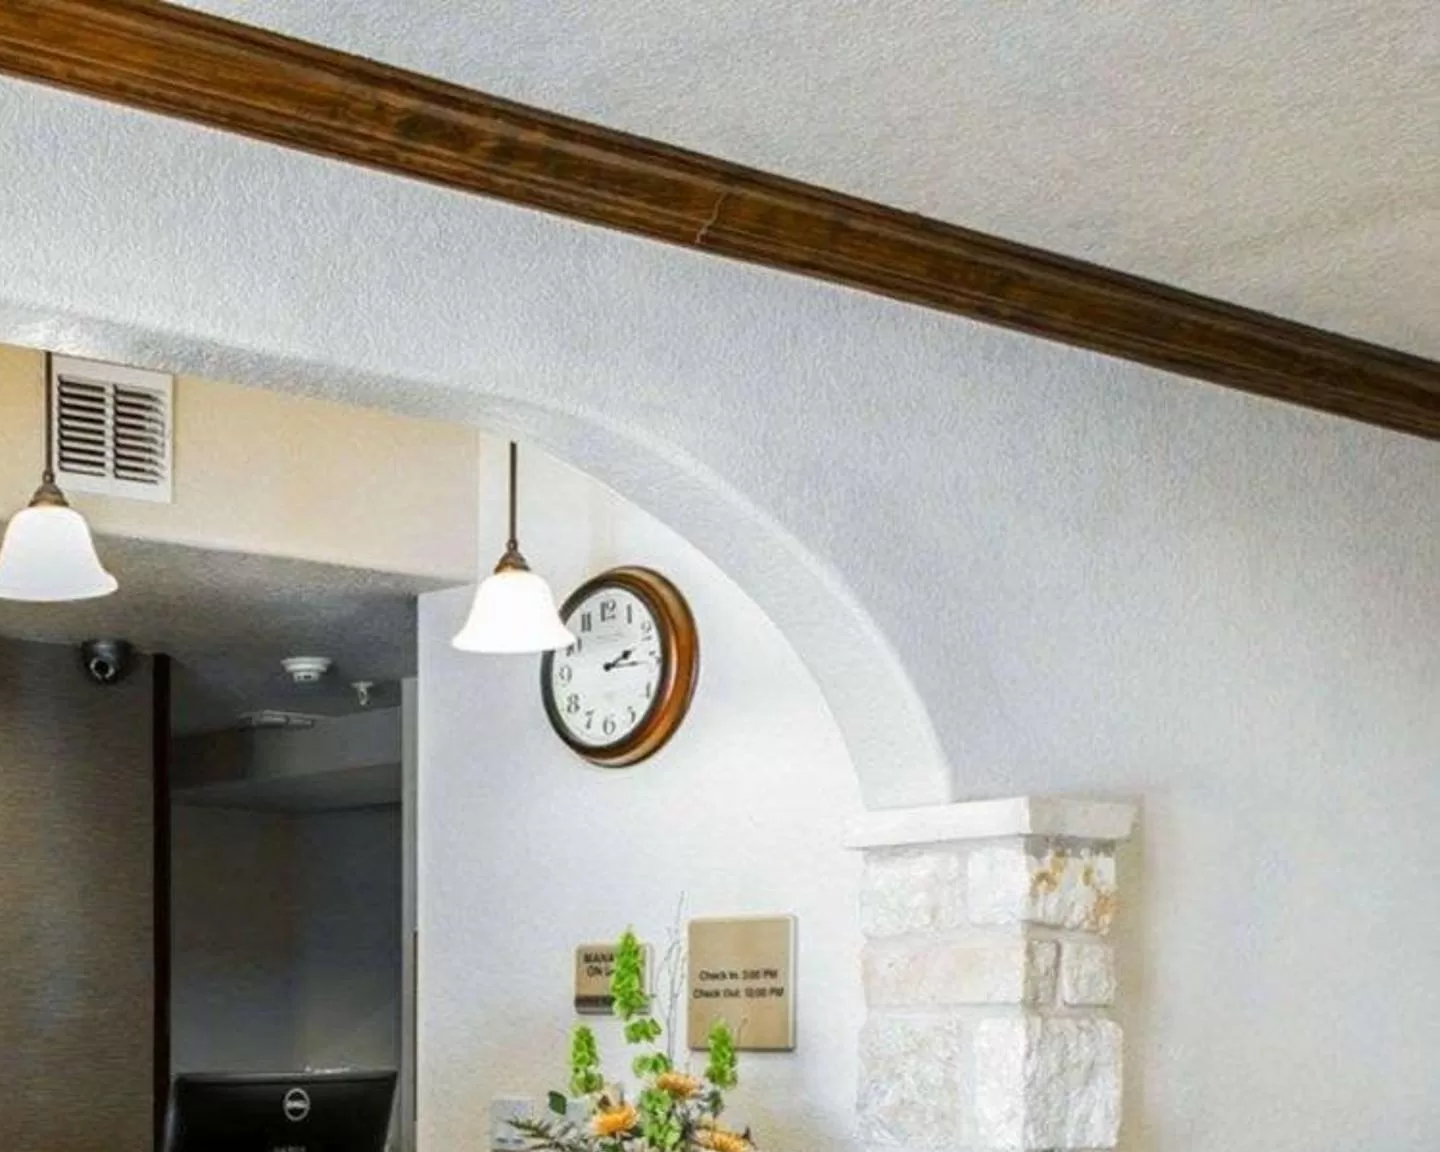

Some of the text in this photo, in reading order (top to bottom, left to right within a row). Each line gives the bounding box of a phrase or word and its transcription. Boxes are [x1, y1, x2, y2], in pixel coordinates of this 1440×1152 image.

[600, 601, 616, 622] 12
[581, 613, 591, 632] 11
[567, 694, 580, 713] 8
[585, 710, 594, 729] 7
[699, 969, 727, 981] Check
[692, 987, 720, 999] Check
